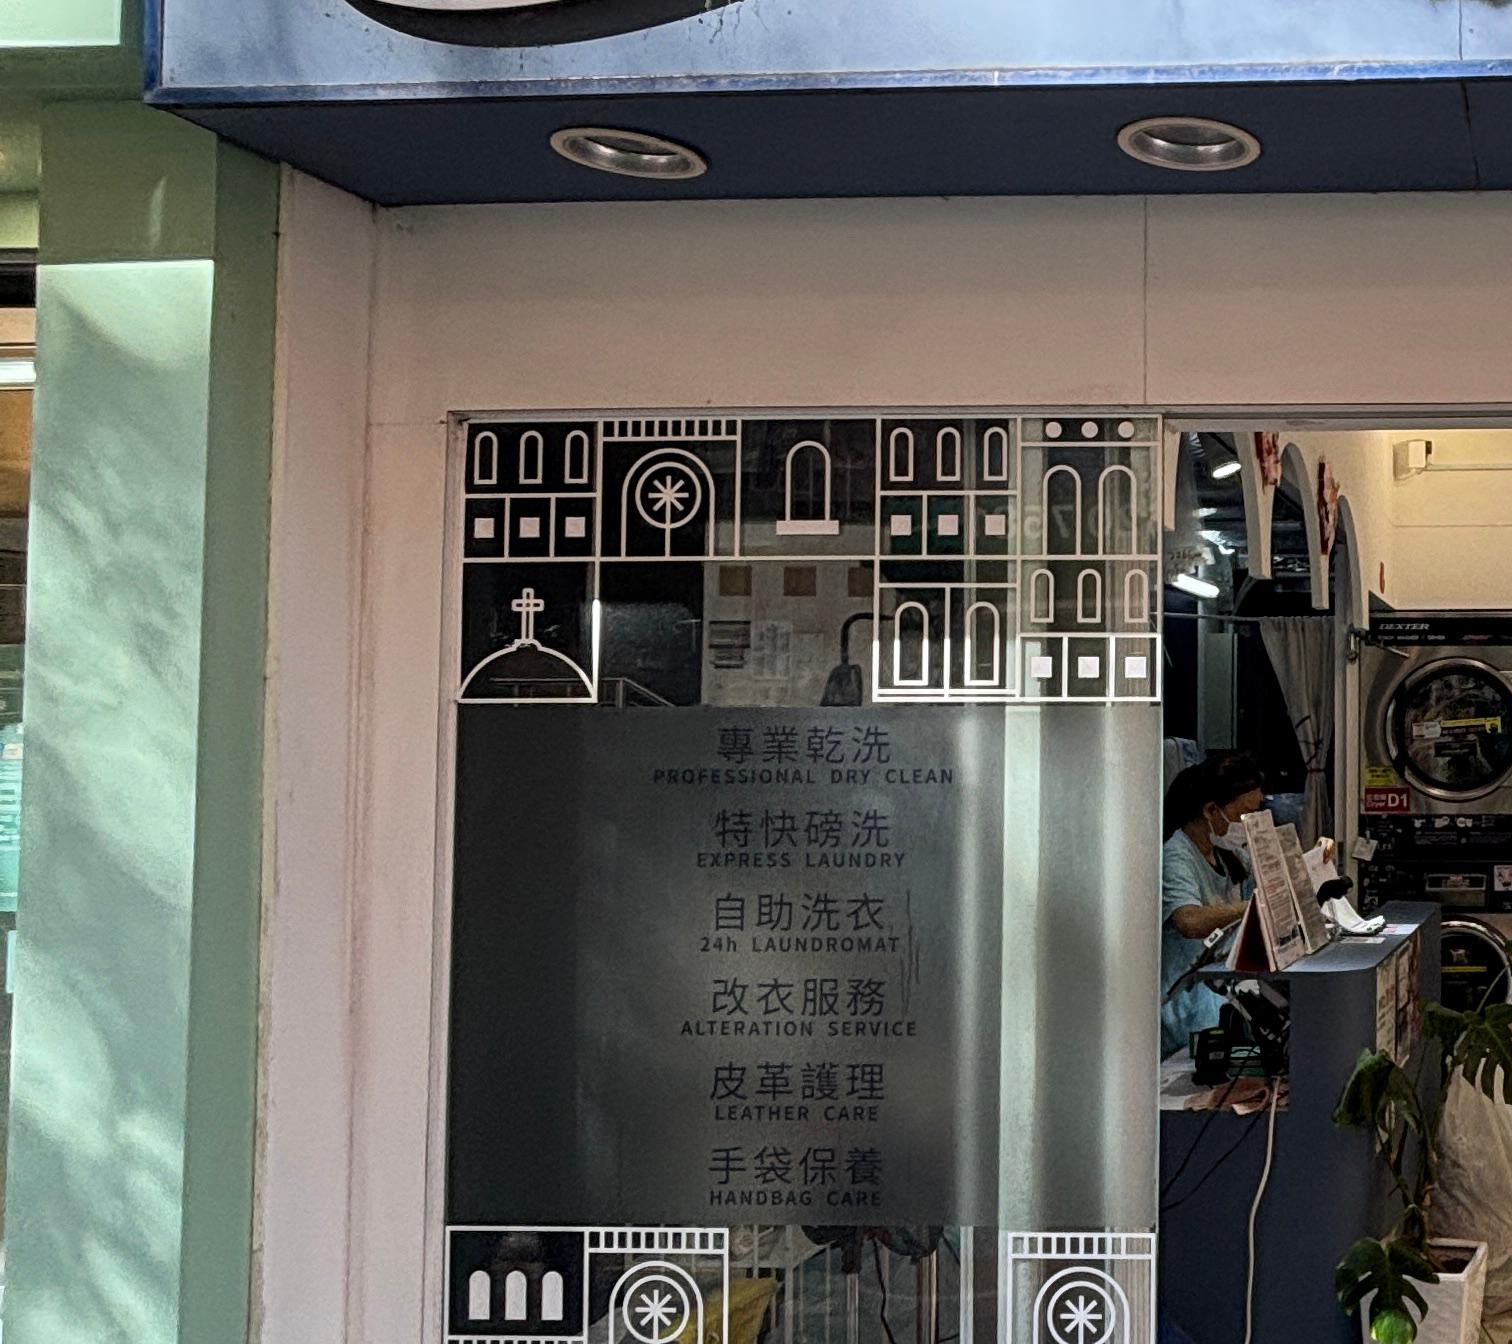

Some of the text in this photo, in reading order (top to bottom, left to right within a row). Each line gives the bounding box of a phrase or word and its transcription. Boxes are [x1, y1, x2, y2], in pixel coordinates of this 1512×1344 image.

[1378, 623, 1431, 631] DEXTER
[715, 724, 892, 765] 專業乾洗
[652, 767, 954, 785] PROFESSIONAL DRY CLEAN
[1387, 793, 1409, 807] D1
[713, 808, 891, 850] 特快磅洗
[696, 852, 906, 869] EXPRESS LAUNDRY
[712, 892, 886, 933] 自助洗衣
[699, 936, 900, 954] 24h LAUNDROMAT
[711, 976, 887, 1018] 改衣服務
[680, 1020, 917, 1037] ALTERATION SERVICE
[709, 1061, 886, 1103] 皮革護理
[713, 1105, 879, 1122] LEATHER CARE
[708, 1146, 884, 1188] 手袋保養
[708, 1190, 882, 1207] HANDBAG CARE
